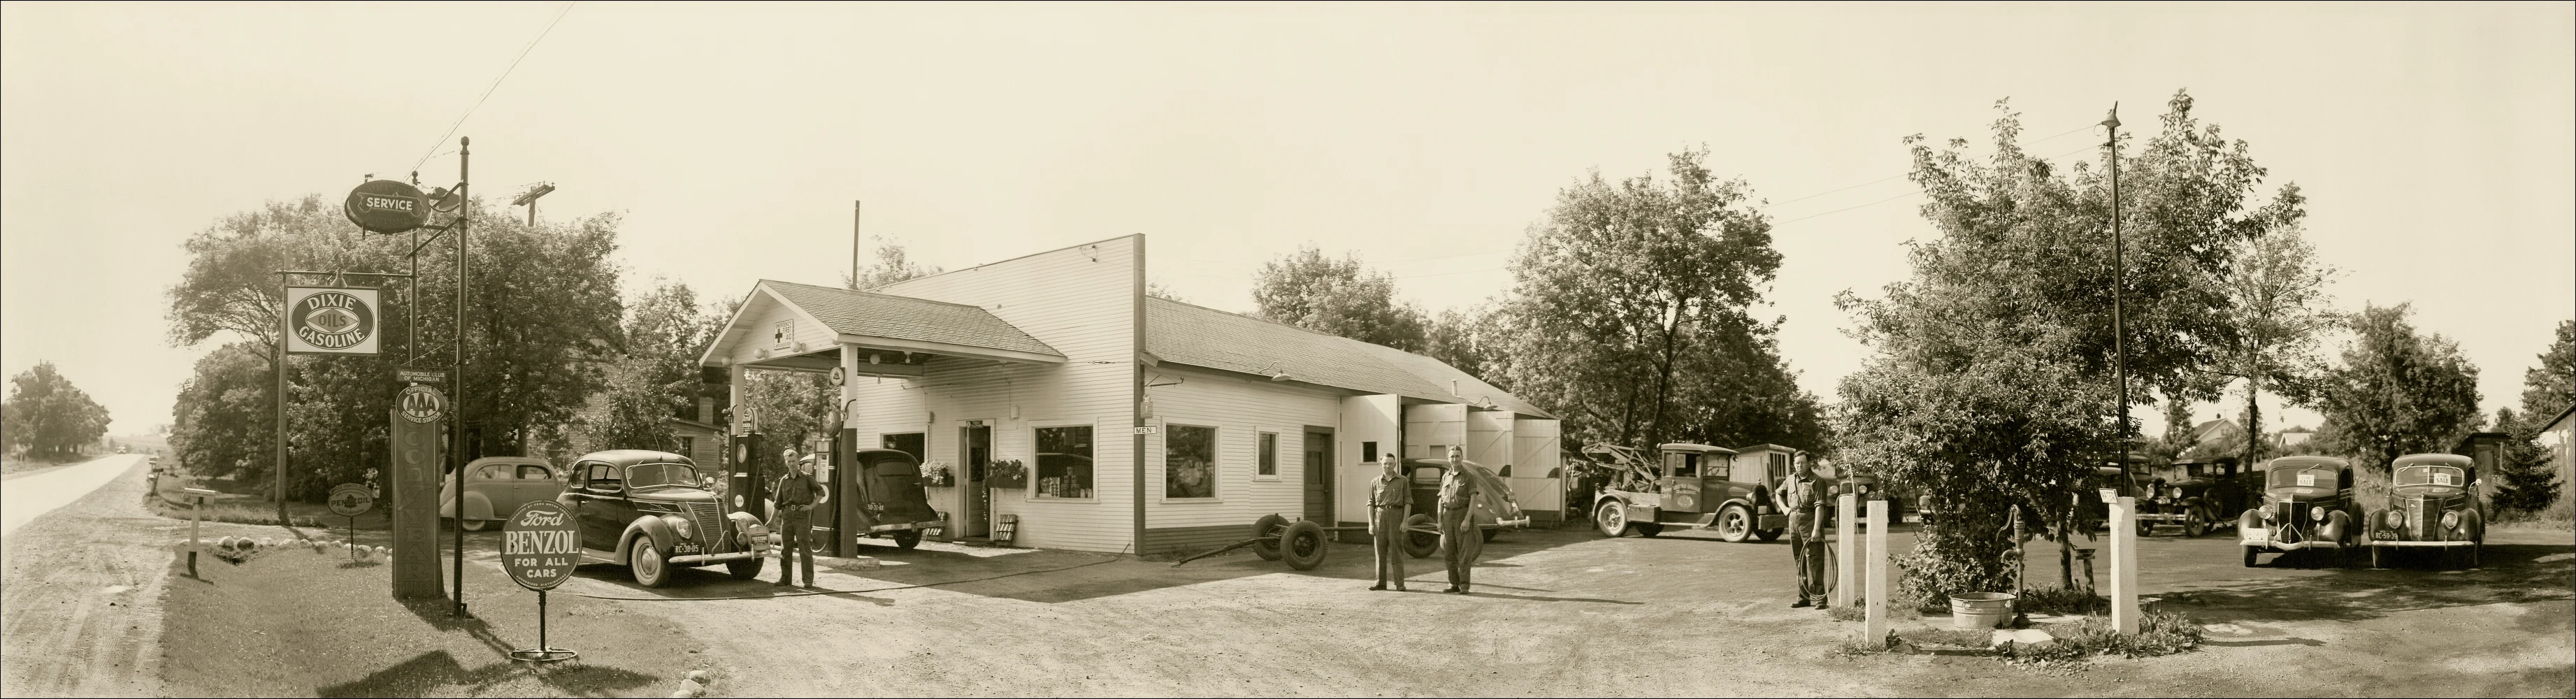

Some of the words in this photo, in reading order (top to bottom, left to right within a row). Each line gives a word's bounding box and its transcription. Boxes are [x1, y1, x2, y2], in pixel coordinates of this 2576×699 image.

[368, 183, 411, 195] UNITED
[366, 197, 412, 210] SERVICE
[307, 294, 357, 310] DIXIE
[318, 314, 347, 327] OILS
[299, 326, 365, 347] GASOLINE
[406, 387, 436, 396] OFFICIAL
[406, 392, 436, 416] AAA
[401, 411, 421, 423] SERVICE
[423, 411, 441, 423] STATION
[331, 497, 370, 507] PENNZOIL
[402, 422, 428, 579] OODYEAR
[511, 507, 526, 523] PRODUCED
[559, 508, 573, 521] COMPANY
[520, 510, 564, 526] Ford
[505, 530, 579, 555] BENZOL
[515, 558, 537, 567] FOR
[545, 557, 568, 566] ALL
[527, 569, 557, 578] CARS
[516, 575, 538, 586] AUTHORIZED
